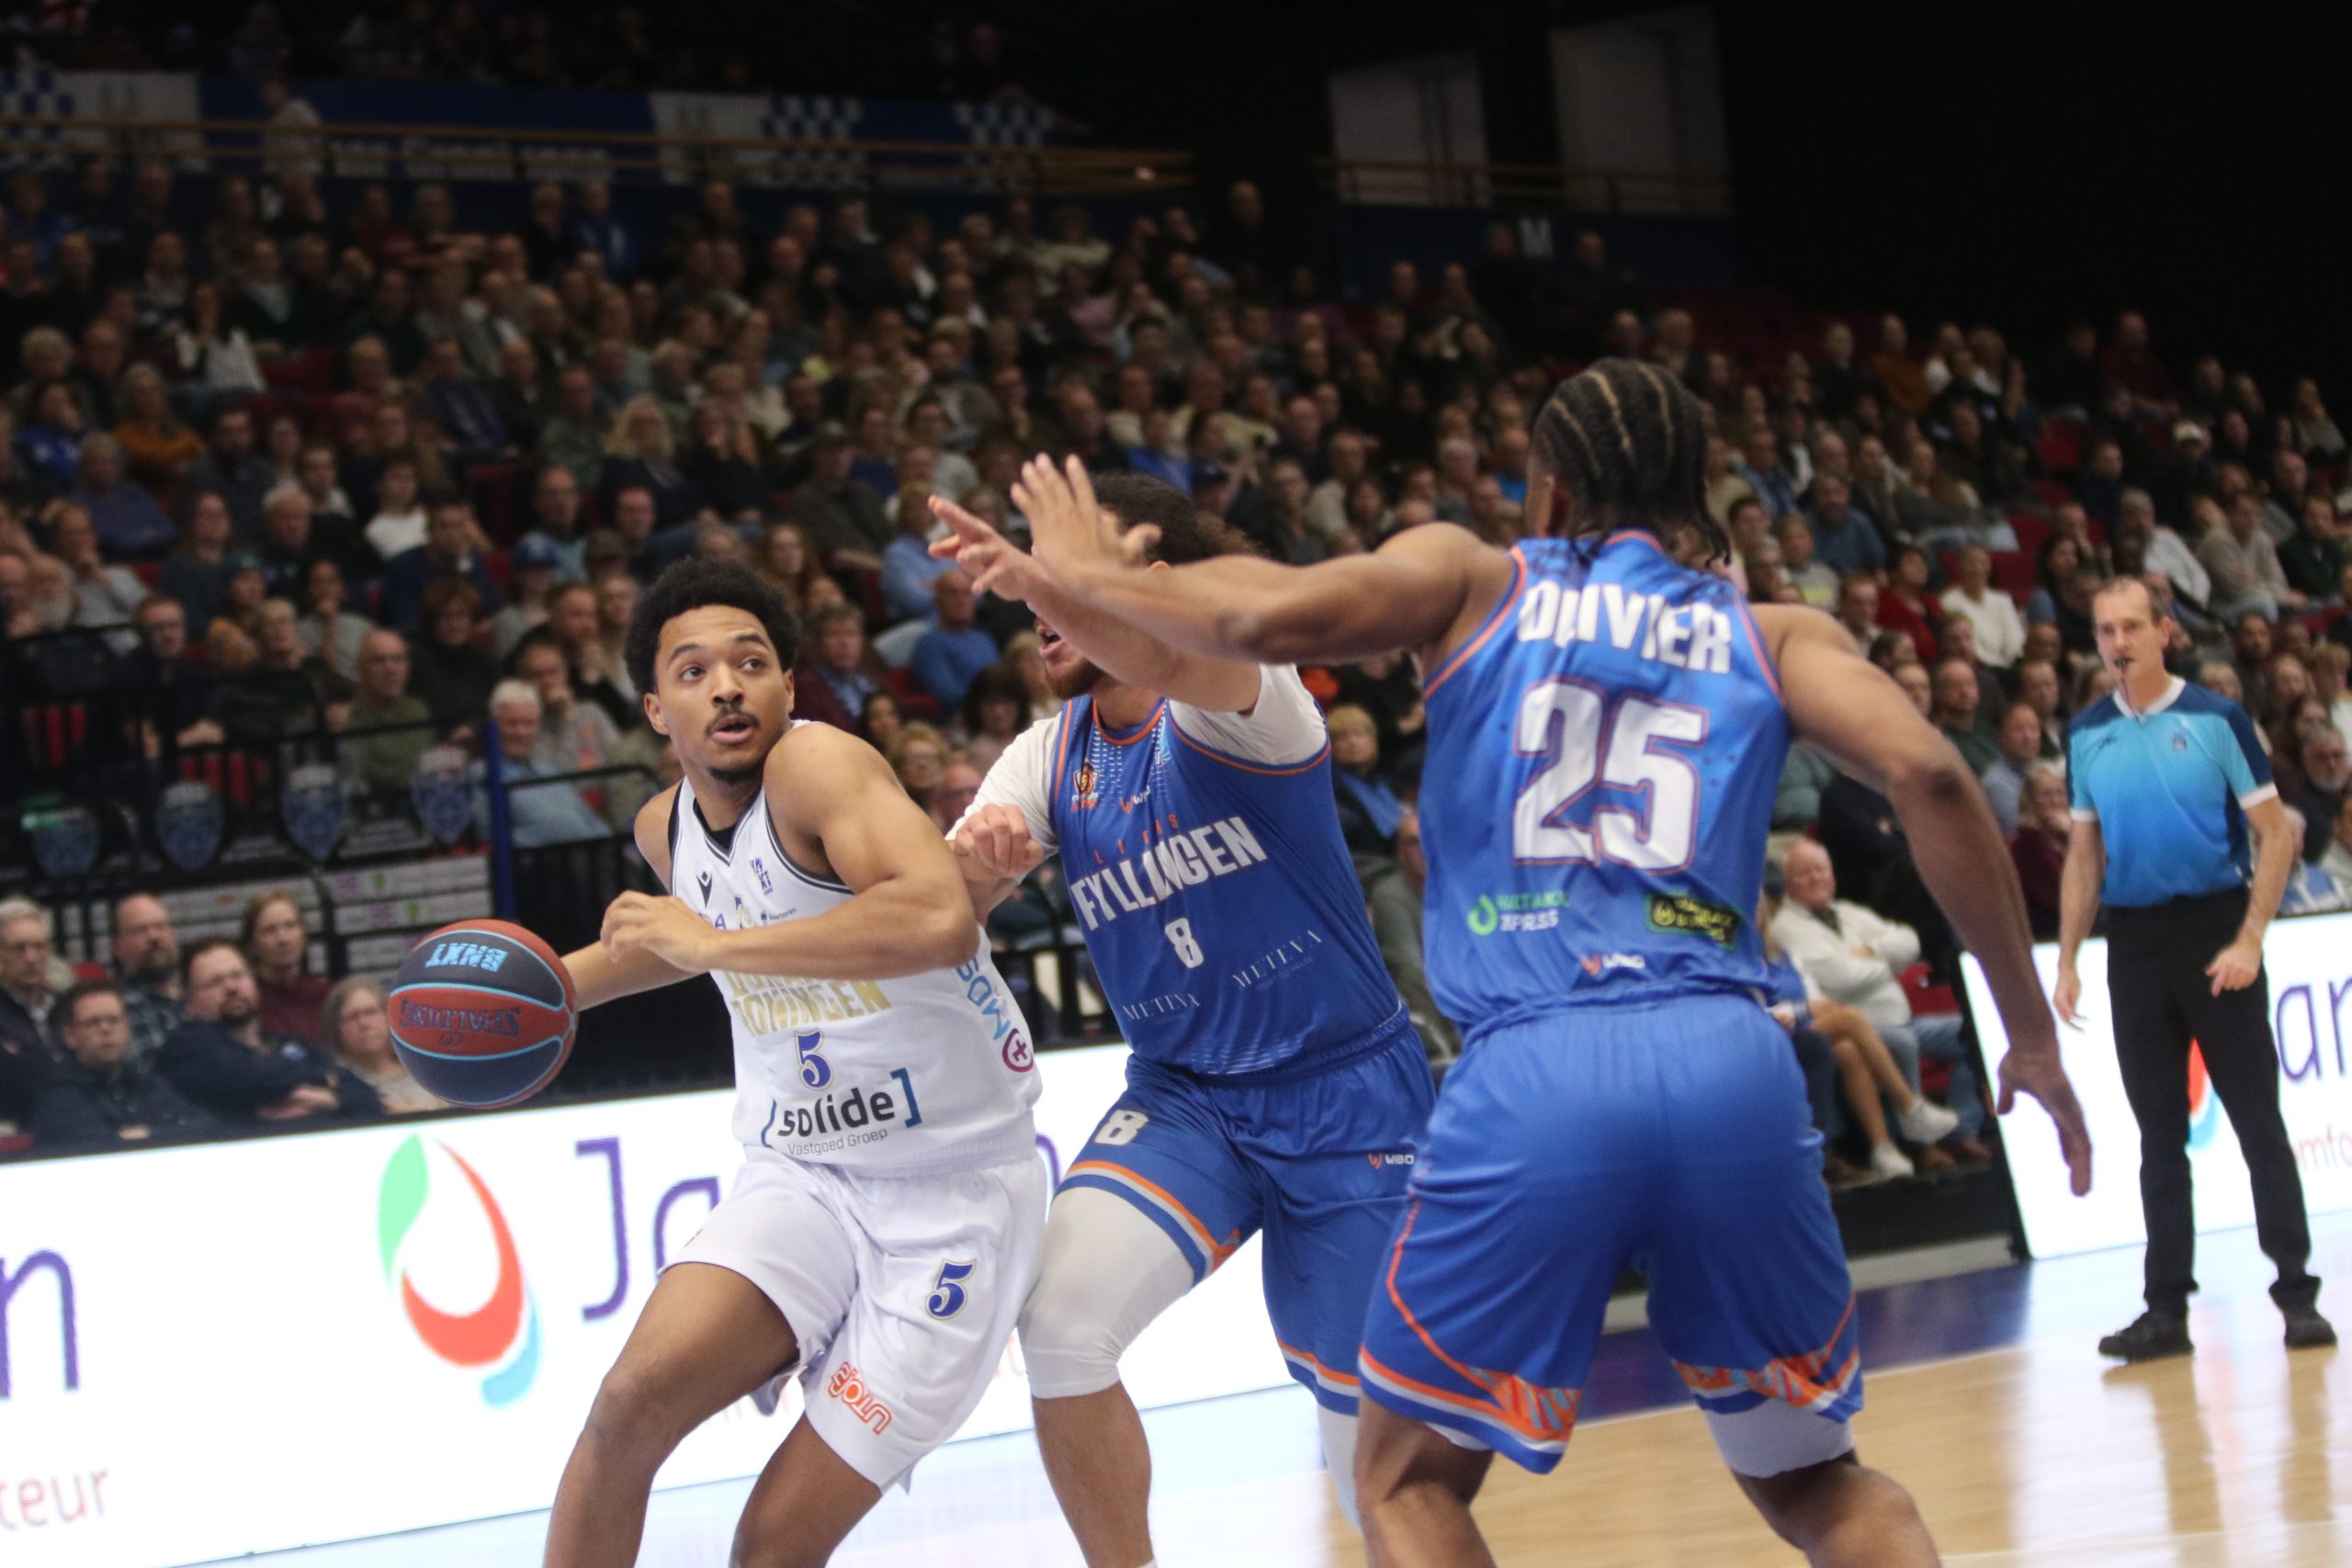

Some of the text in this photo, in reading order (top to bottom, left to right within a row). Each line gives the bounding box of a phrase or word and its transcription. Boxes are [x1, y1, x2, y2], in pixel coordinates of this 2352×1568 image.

[1512, 676, 1710, 876] 25
[1070, 816, 1268, 931] FYLLINGEN
[425, 942, 509, 973] BNXT
[1164, 917, 1204, 969] 8
[399, 998, 521, 1037] SPALDING
[795, 1029, 834, 1091] 5
[787, 1128, 888, 1156] Vastgoed Groep
[1094, 1109, 1149, 1145] 8
[925, 1258, 977, 1321] 5
